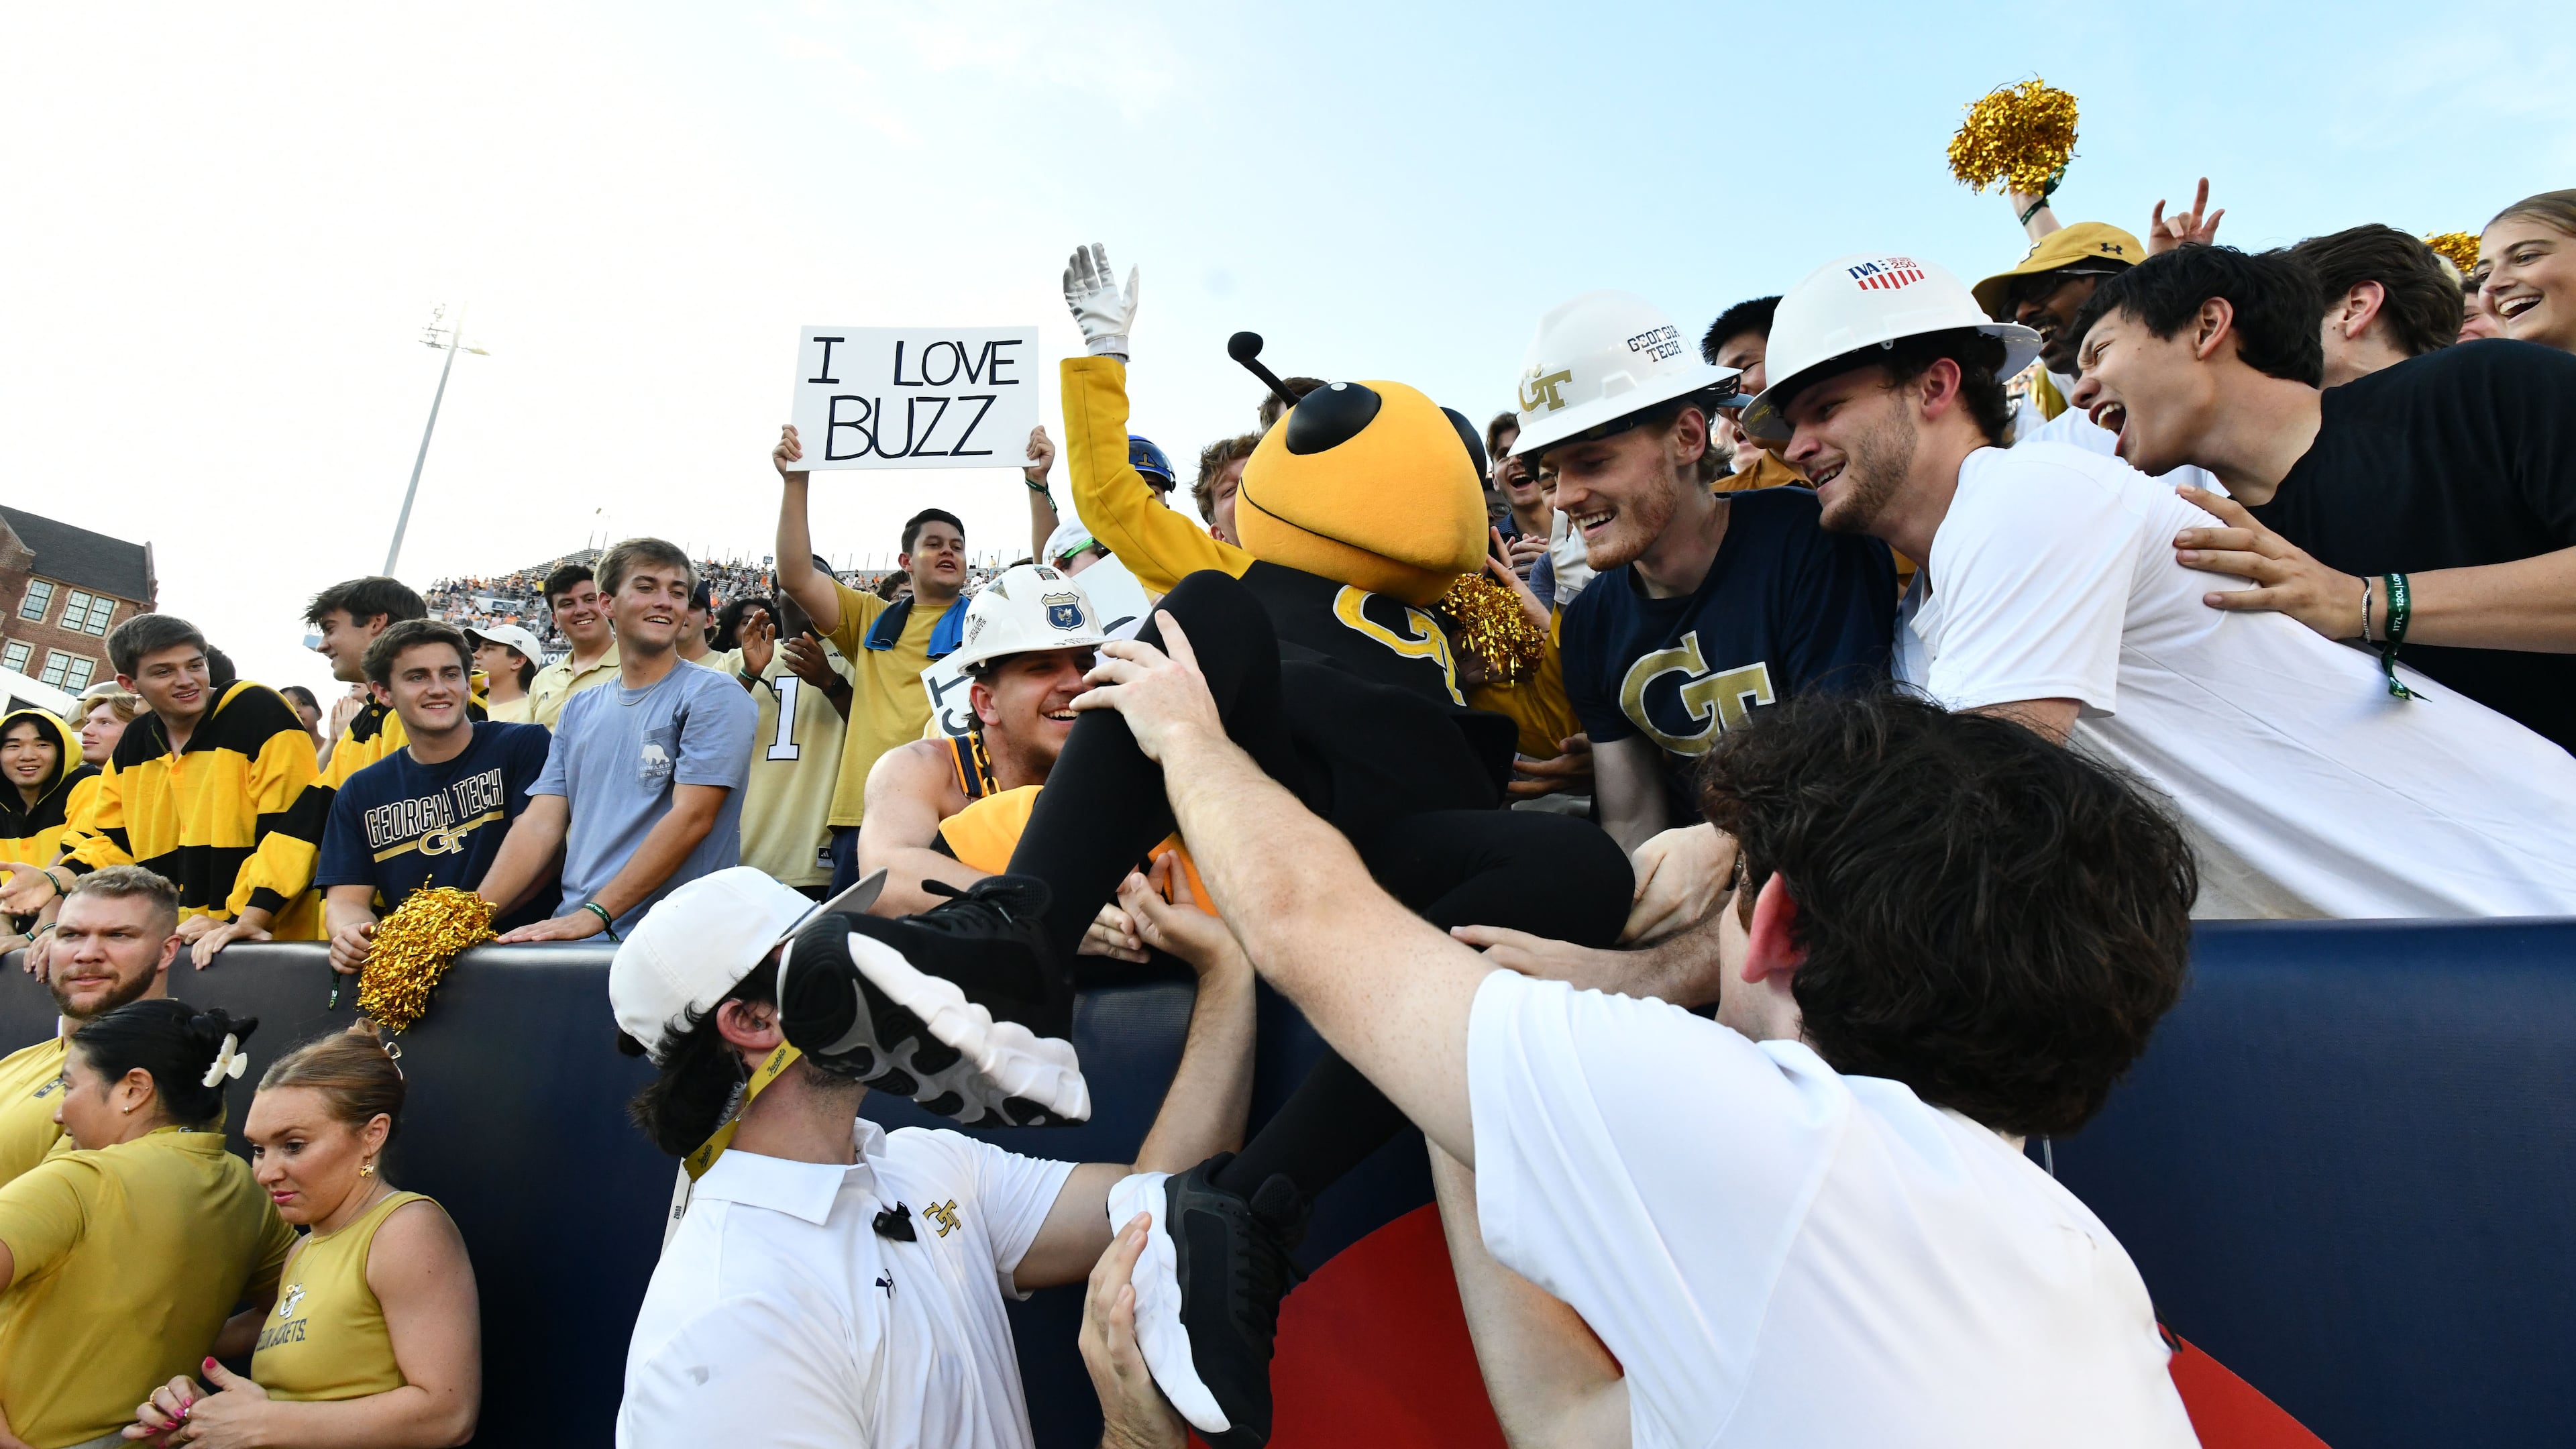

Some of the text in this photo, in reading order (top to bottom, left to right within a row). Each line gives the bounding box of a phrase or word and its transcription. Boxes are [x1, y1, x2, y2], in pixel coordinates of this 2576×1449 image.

[1845, 262, 1881, 279] TVA
[1627, 325, 1680, 352] GEORGIA
[1646, 341, 1682, 362] TECH
[808, 337, 1022, 386] I LOVE
[1518, 363, 1572, 412] GT
[825, 394, 997, 460] BUZZ
[1619, 630, 1776, 757] GT
[766, 676, 800, 761] 1
[364, 767, 504, 849] GEORGIA TECH
[418, 826, 468, 856] GT
[767, 1048, 786, 1077] Jackets
[922, 1199, 962, 1238] GT
